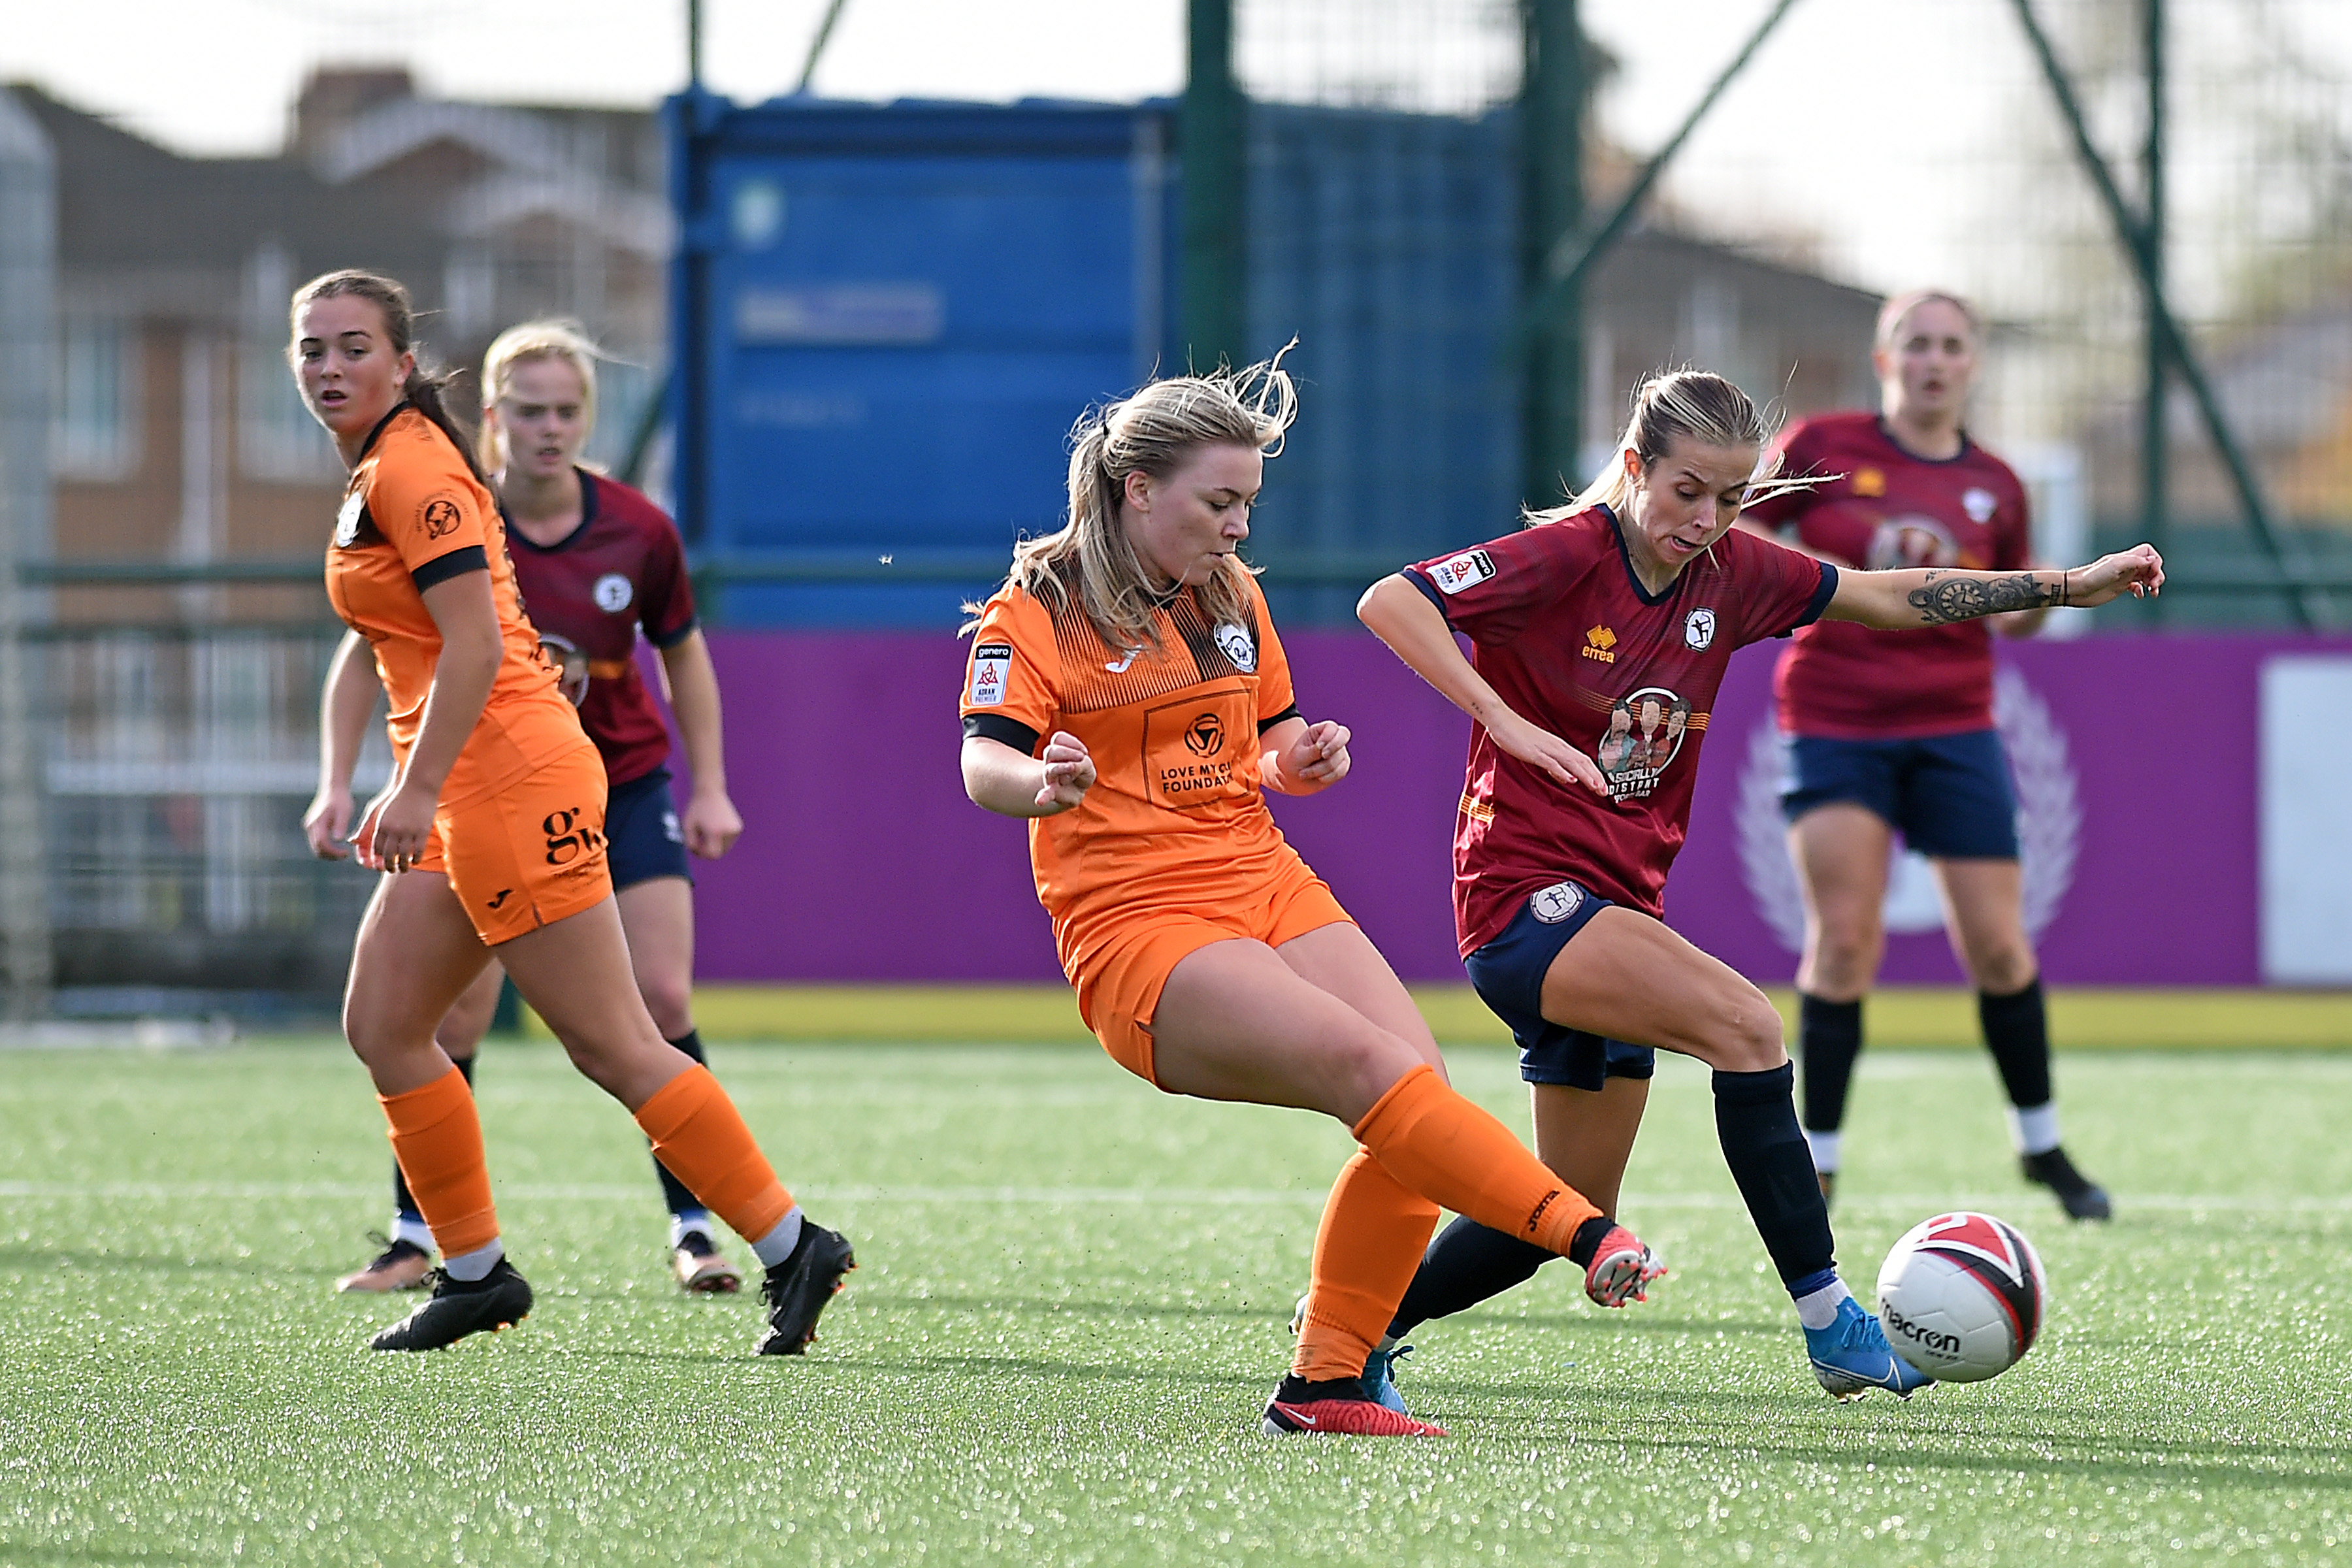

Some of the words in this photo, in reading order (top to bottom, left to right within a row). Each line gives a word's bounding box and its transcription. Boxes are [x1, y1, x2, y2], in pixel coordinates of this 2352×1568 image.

[978, 648, 1009, 658] genero
[1582, 645, 1614, 664] errea
[1161, 766, 1194, 780] LOVE
[1200, 763, 1216, 776] MY
[1609, 777, 1659, 795] DISTANT
[1529, 1190, 1561, 1232] Joma
